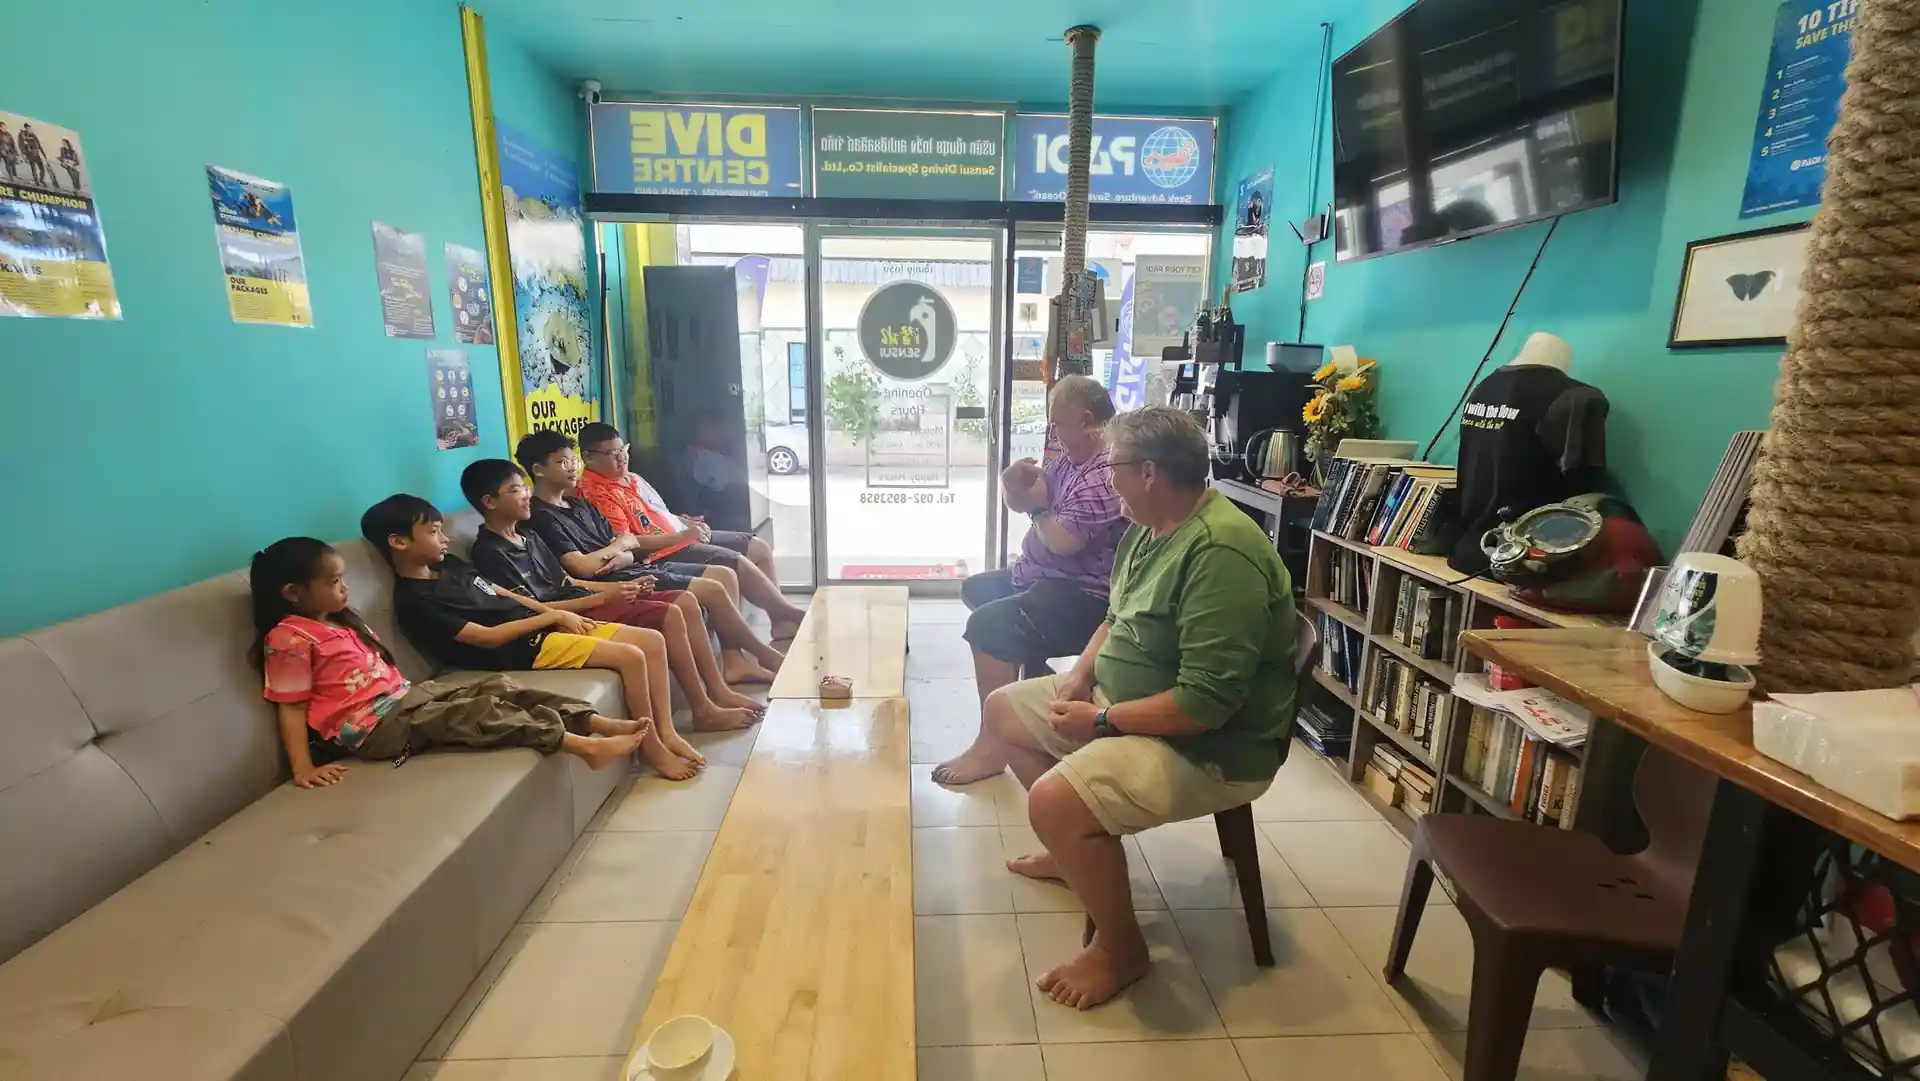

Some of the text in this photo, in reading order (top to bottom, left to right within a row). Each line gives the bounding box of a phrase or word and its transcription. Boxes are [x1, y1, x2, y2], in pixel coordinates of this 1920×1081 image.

[1798, 9, 1823, 34] 10
[1796, 16, 1857, 50] SAVE THE
[1776, 69, 1784, 80] 1
[1772, 88, 1781, 100] 2
[1767, 108, 1777, 120] 3
[1764, 127, 1774, 138] 4
[1760, 146, 1769, 157] 5
[18, 189, 88, 209] CHUMPHON
[229, 276, 247, 286] OUR
[231, 284, 268, 295] PACKAGES
[531, 400, 557, 420] OUR
[1467, 402, 1521, 420] with the flow
[533, 417, 589, 436] PACKAGES
